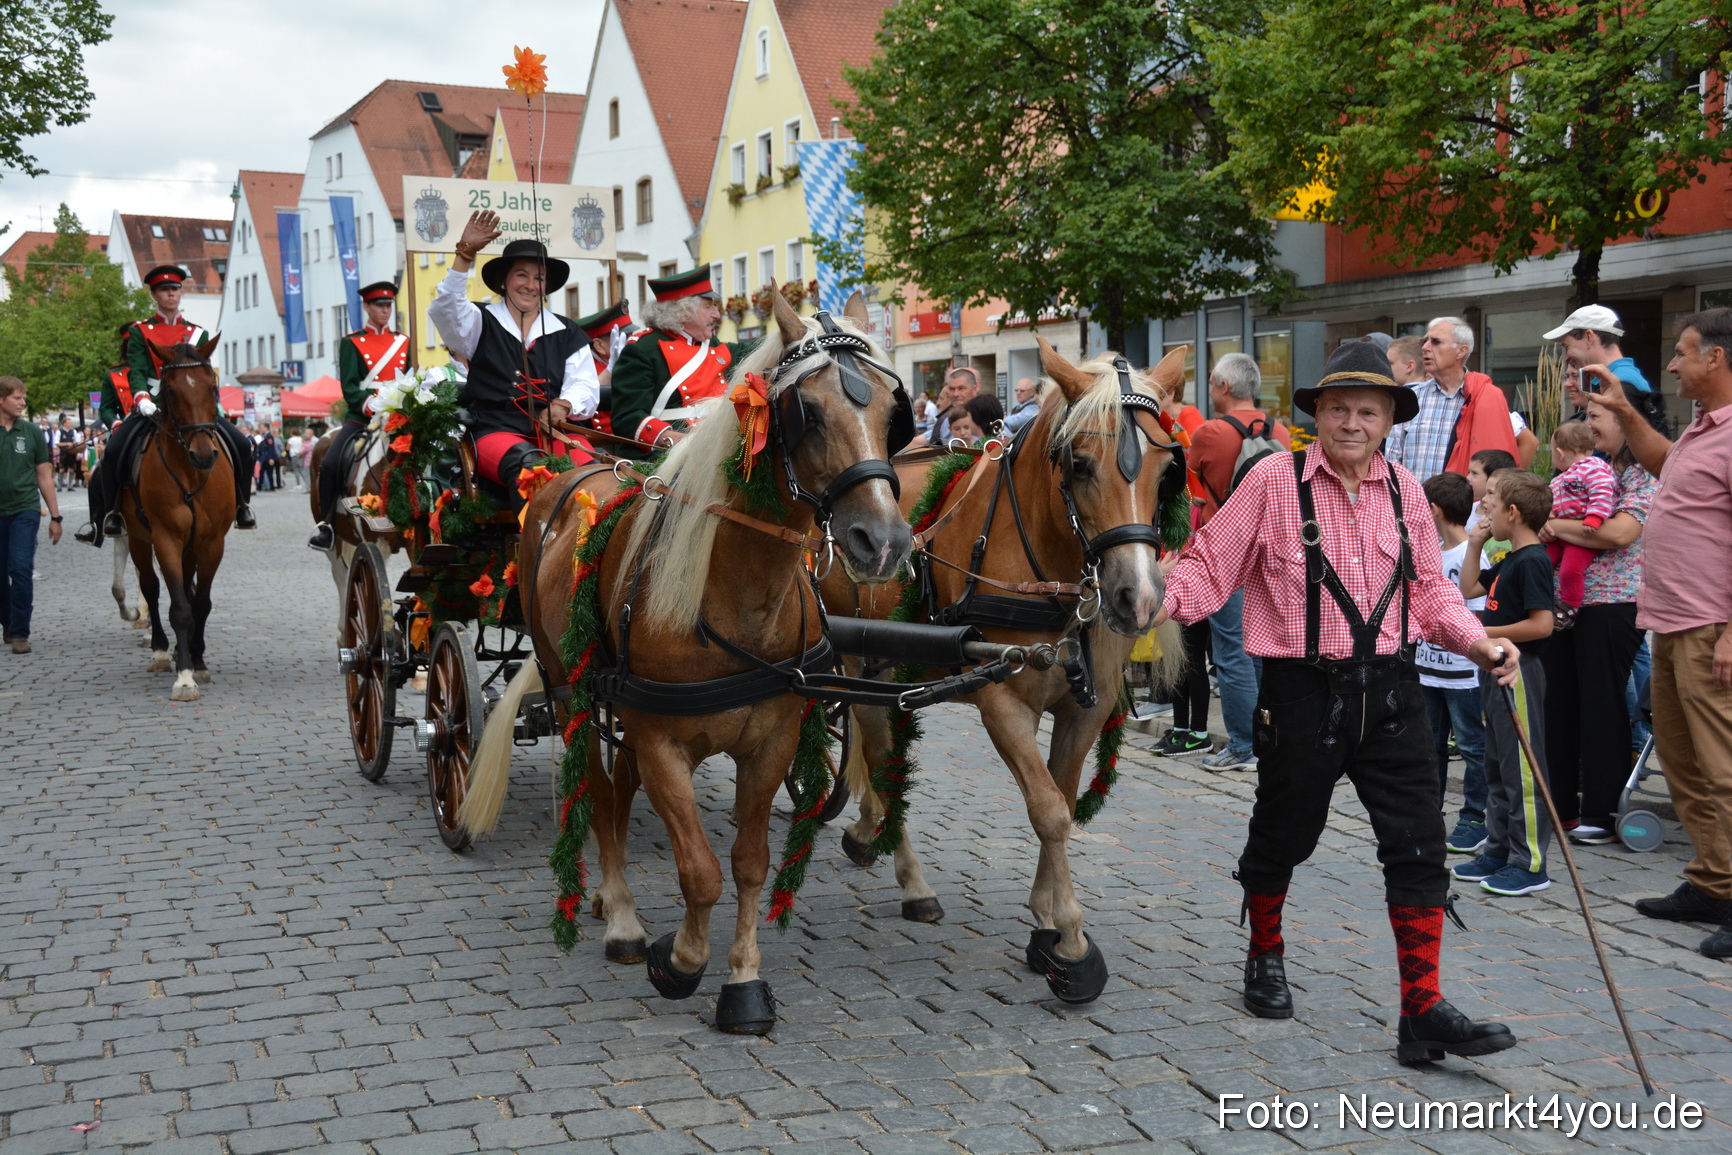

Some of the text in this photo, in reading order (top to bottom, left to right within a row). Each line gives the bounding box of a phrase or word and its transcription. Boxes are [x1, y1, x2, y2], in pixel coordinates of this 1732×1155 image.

[468, 189, 552, 212] 25 Jahre
[494, 219, 552, 236] vauleger
[884, 303, 892, 349] KINO
